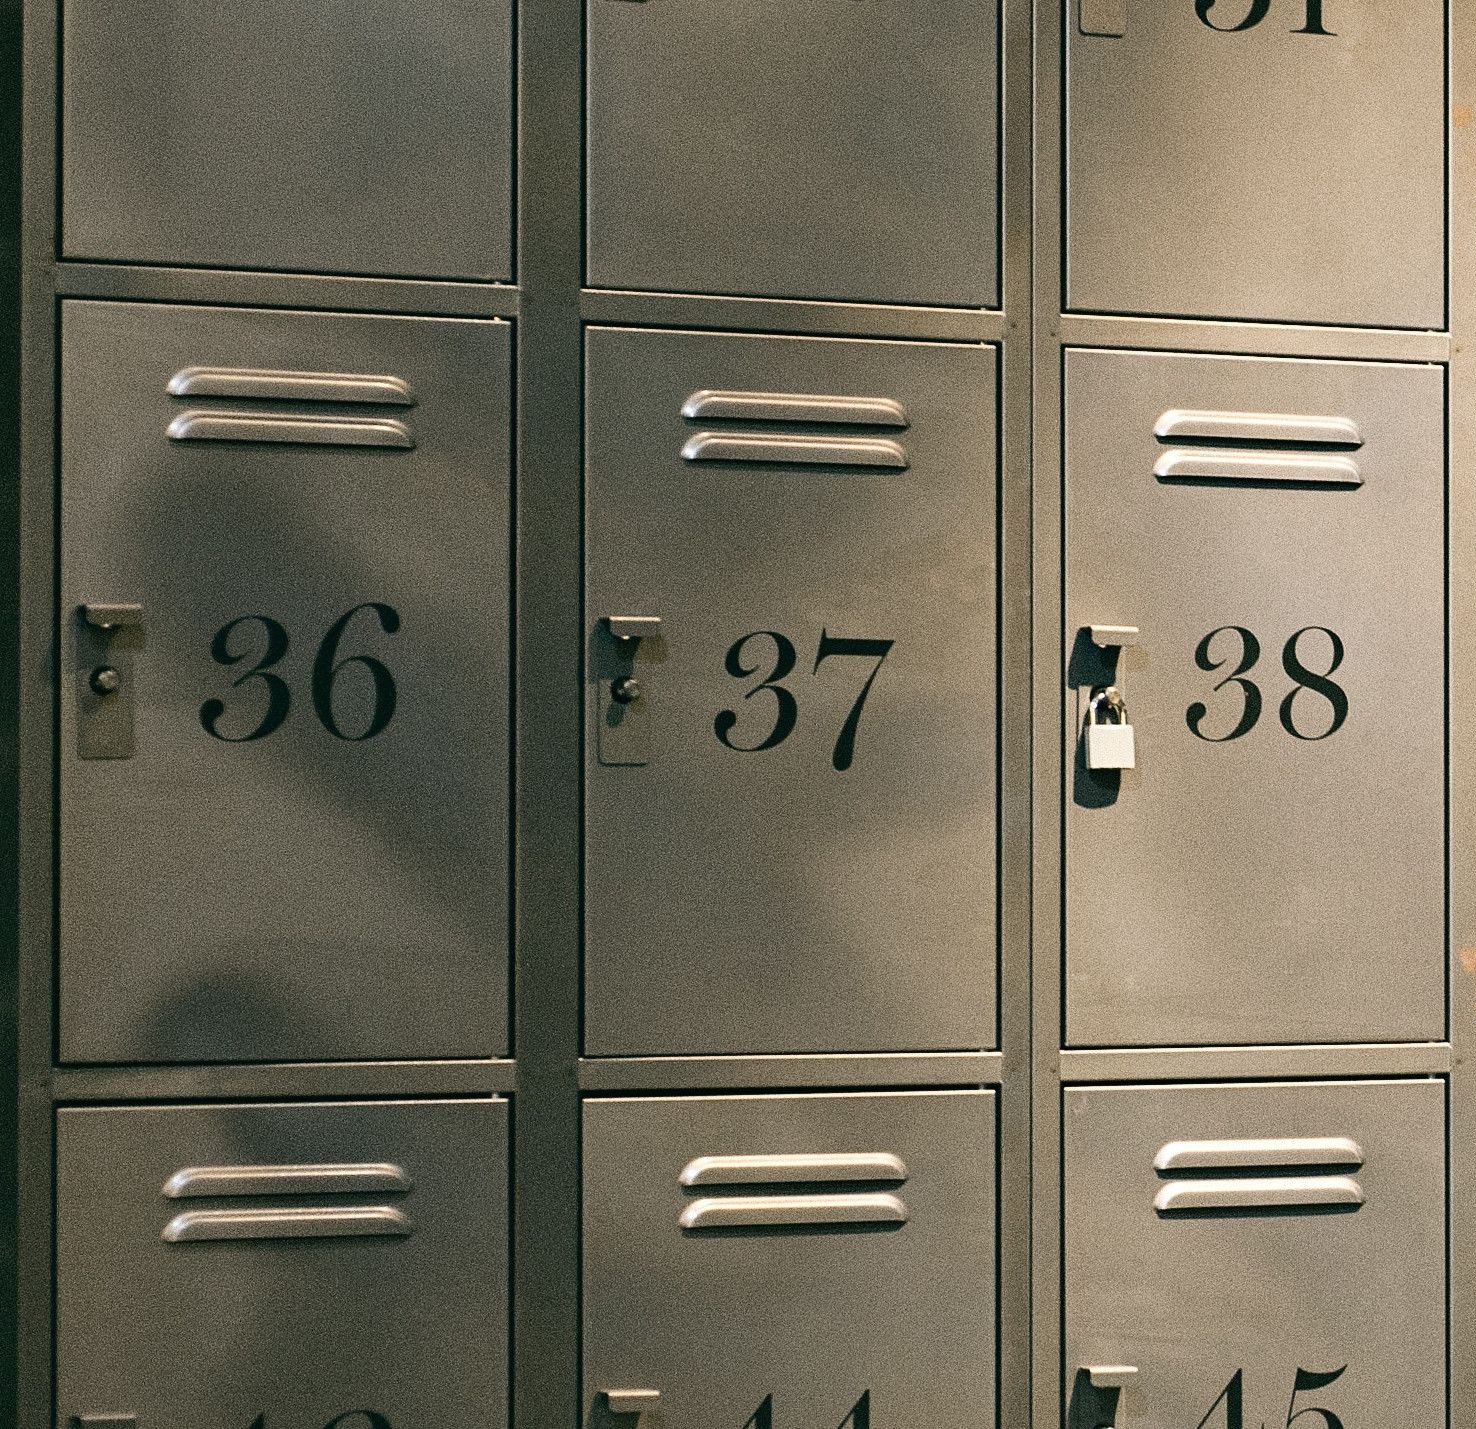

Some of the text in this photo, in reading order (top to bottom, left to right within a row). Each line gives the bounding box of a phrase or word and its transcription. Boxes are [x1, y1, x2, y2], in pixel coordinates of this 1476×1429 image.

[199, 602, 402, 744] 36
[712, 630, 895, 773] 37
[1184, 625, 1351, 743] 38
